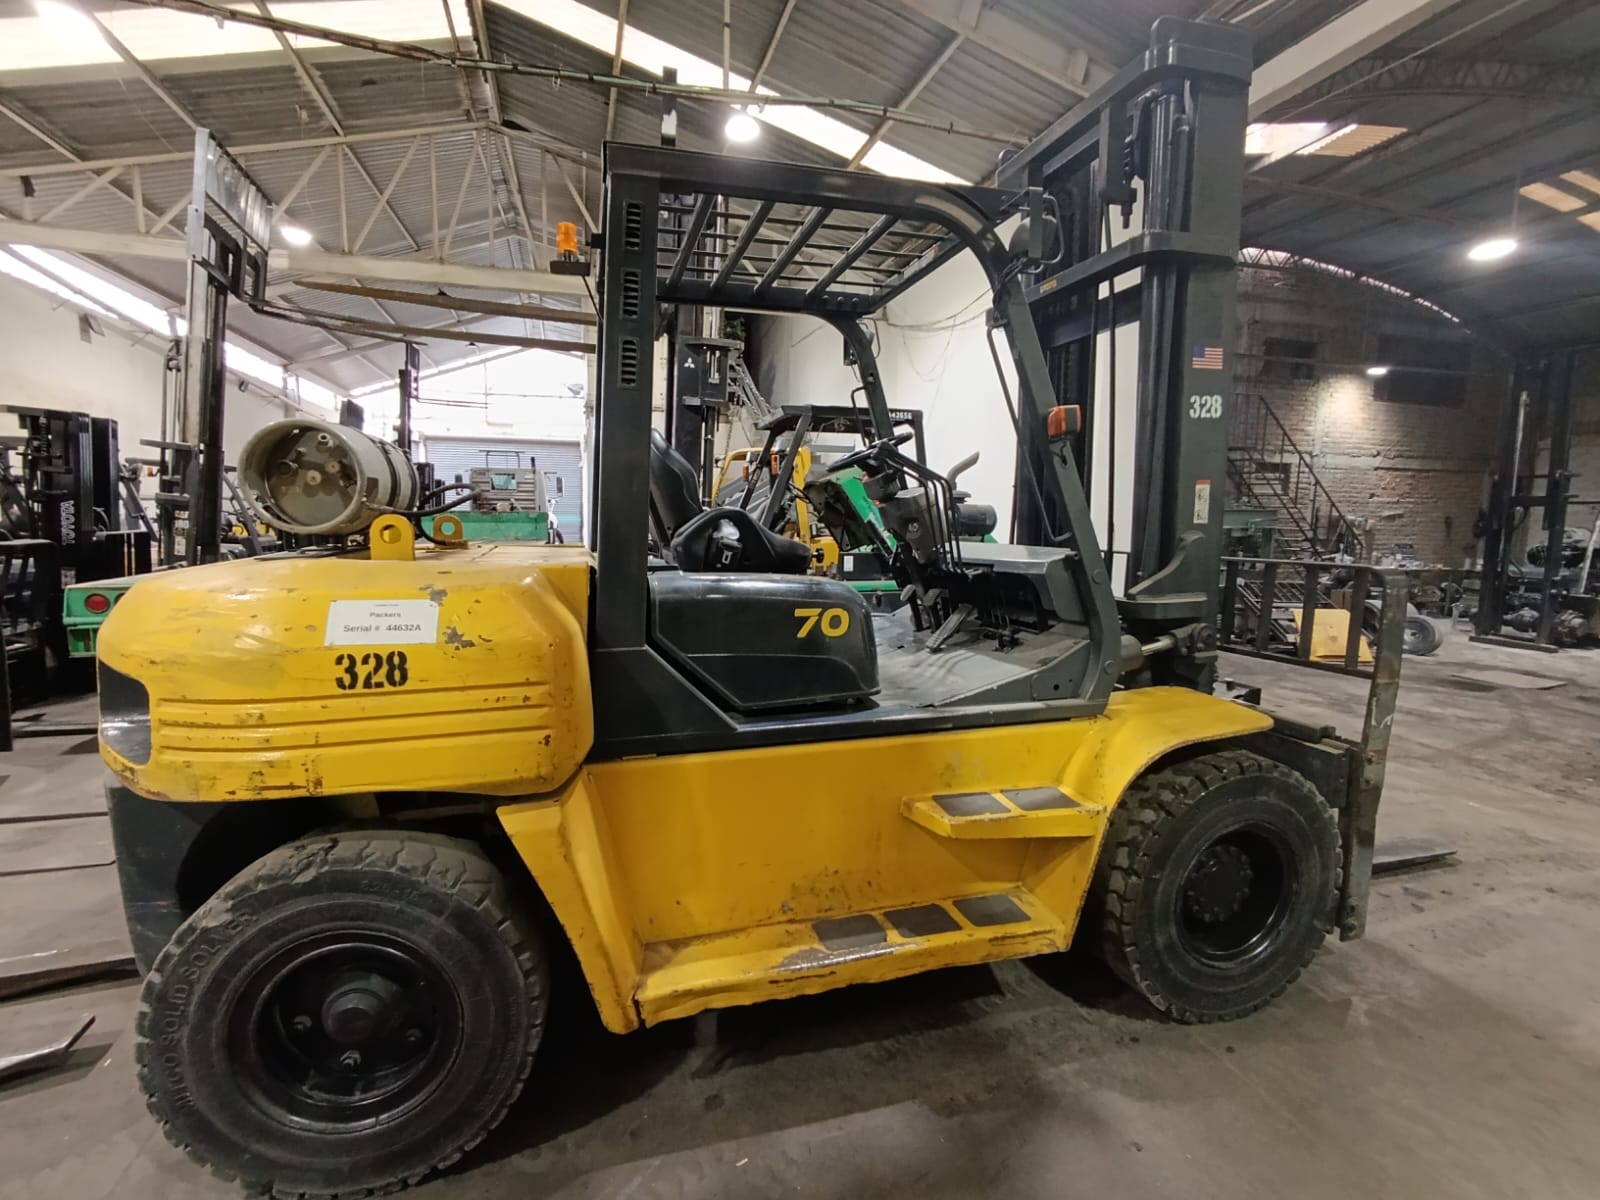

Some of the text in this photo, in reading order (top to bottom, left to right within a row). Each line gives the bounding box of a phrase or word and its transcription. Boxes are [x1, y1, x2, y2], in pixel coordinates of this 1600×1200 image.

[1188, 394, 1222, 419] 328
[60, 500, 75, 546] TOYOTA
[343, 624, 372, 633] Serial
[385, 623, 422, 632] 44632A
[794, 607, 850, 638] 70
[335, 650, 409, 690] 328
[161, 984, 190, 1047] SOLID
